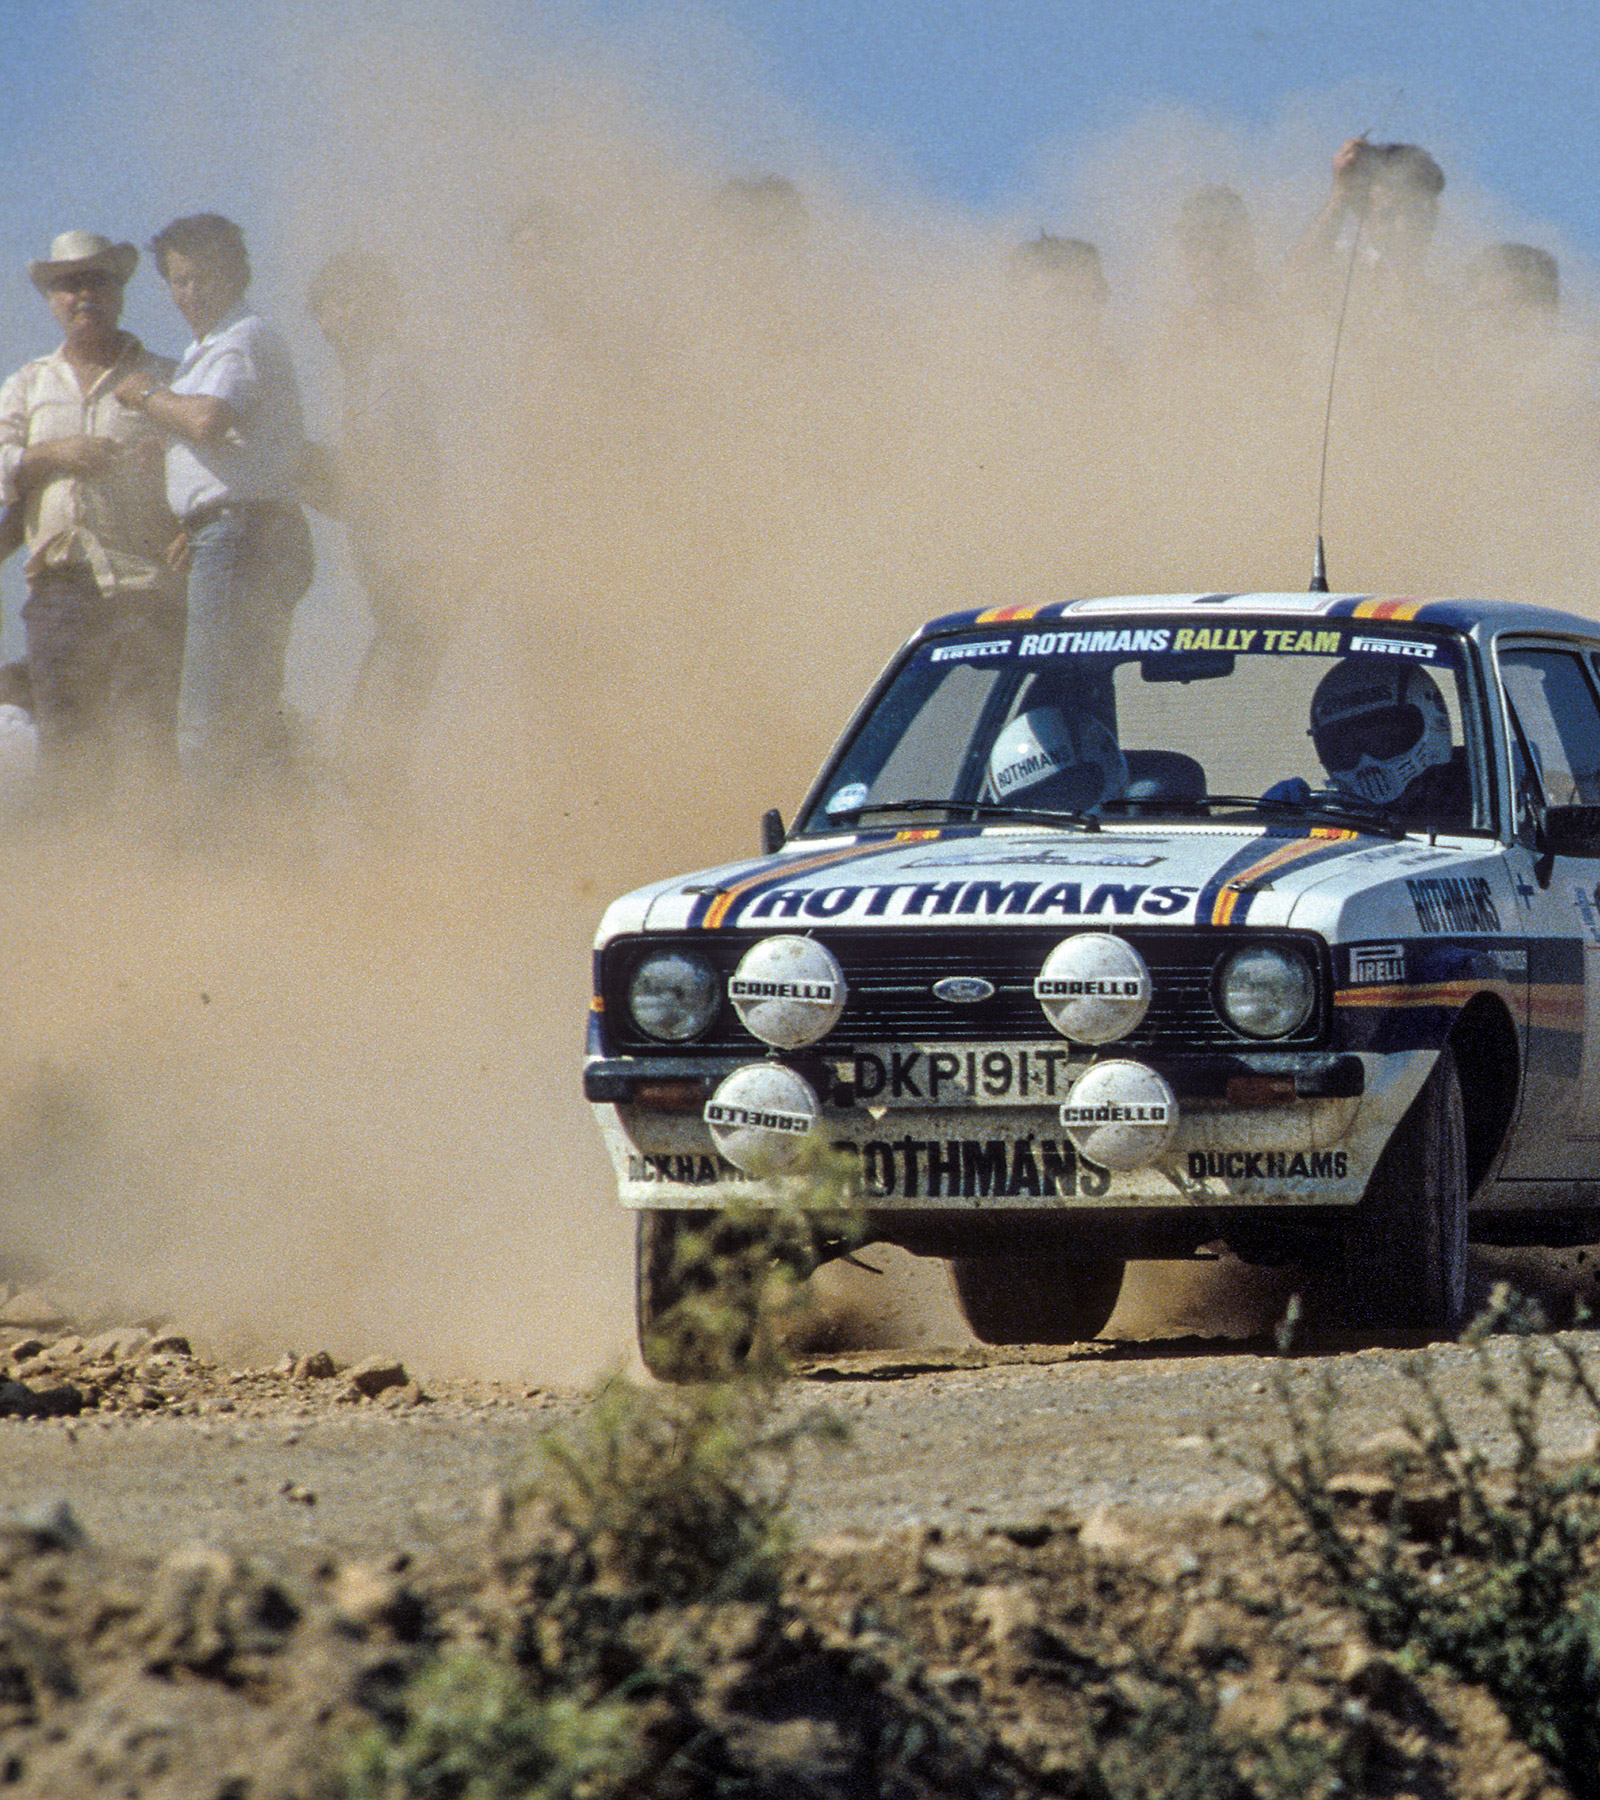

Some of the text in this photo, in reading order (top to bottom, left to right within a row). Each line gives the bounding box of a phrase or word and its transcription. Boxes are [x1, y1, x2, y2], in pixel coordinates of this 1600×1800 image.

[931, 640, 1012, 662] PIRELLI
[1018, 628, 1341, 656] ROTHMANS RALLY TEAM
[1350, 636, 1437, 658] PIRELLI
[752, 880, 1200, 918] ROTHMANS
[1349, 944, 1405, 982] PIRELLI
[732, 982, 831, 999] CARELLO
[1038, 981, 1139, 996] CARELLO
[708, 1106, 809, 1132] CARELLO
[1065, 1107, 1164, 1121] CARELLO
[1188, 1151, 1348, 1178] DUCKHAMS
